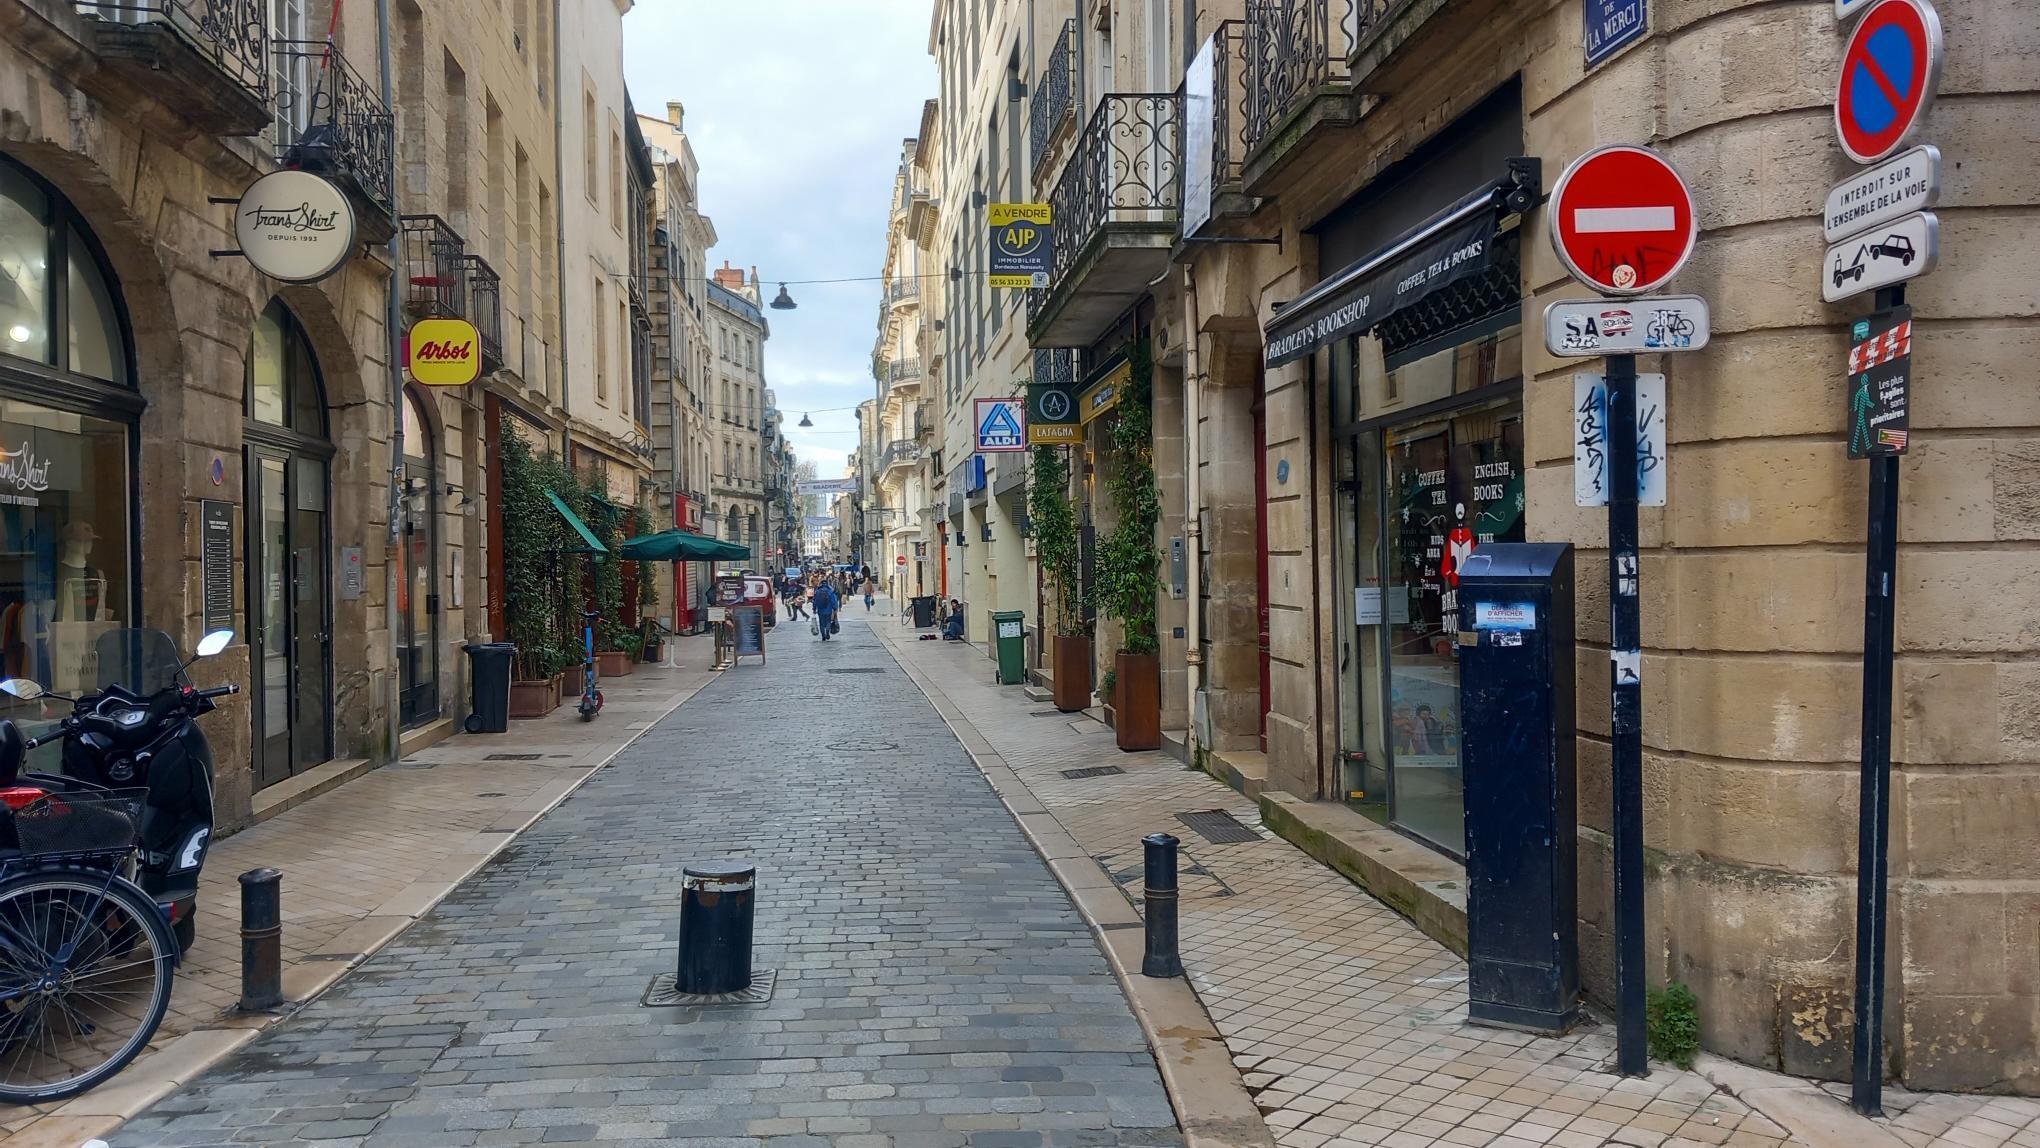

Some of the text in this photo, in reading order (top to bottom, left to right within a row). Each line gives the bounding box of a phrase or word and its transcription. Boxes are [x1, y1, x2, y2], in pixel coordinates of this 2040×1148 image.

[1604, 1, 1615, 17] DE
[1588, 2, 1637, 52] LA MERCI
[1840, 166, 1911, 207] INTERDIT SUR
[993, 208, 1048, 219] A VENDRE
[1827, 179, 1927, 230] L'ENSEMBLE DE LA VOIE
[1004, 228, 1035, 249] AJP
[1397, 239, 1483, 295] COFFEE, TEA & BOOKS
[1267, 295, 1370, 361] BRADLEY'S BOOKSHOP
[416, 340, 472, 361] Arbol
[1878, 375, 1904, 390] Les plus
[1889, 397, 1905, 409] sont
[1870, 409, 1905, 428] prioritaires
[983, 436, 1017, 446] ALDI
[1418, 469, 1446, 487] COFFEE
[1474, 461, 1510, 479] ENGLISH
[1431, 490, 1447, 505] TEA
[1473, 483, 1504, 501] BOOKS
[1430, 535, 1445, 545] KIDS
[1478, 532, 1494, 544] FREE
[1426, 548, 1441, 558] AREA
